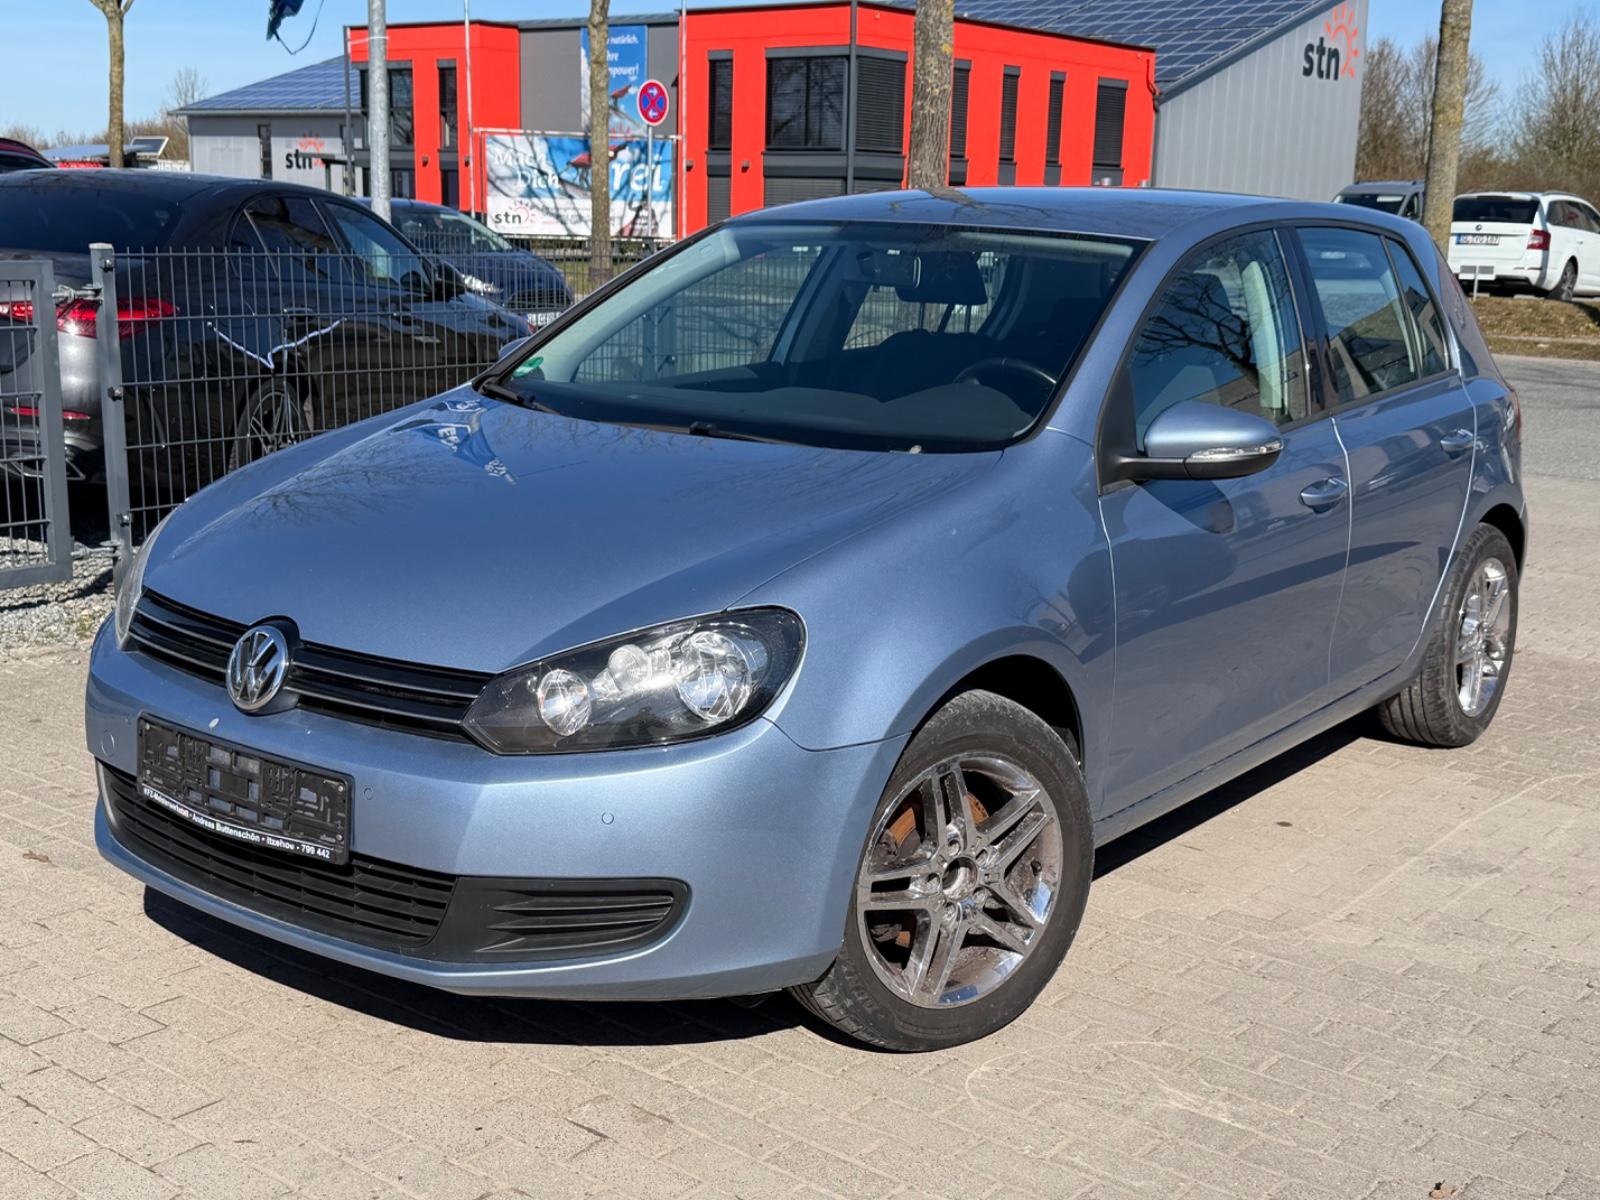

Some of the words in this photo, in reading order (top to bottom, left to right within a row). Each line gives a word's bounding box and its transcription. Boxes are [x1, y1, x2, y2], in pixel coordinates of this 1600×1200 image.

[606, 50, 619, 61] hre
[1302, 36, 1340, 82] stn
[285, 148, 313, 170] stn
[612, 154, 664, 191] rei
[493, 211, 522, 226] stn
[301, 844, 316, 855] 799
[316, 849, 331, 860] 442
